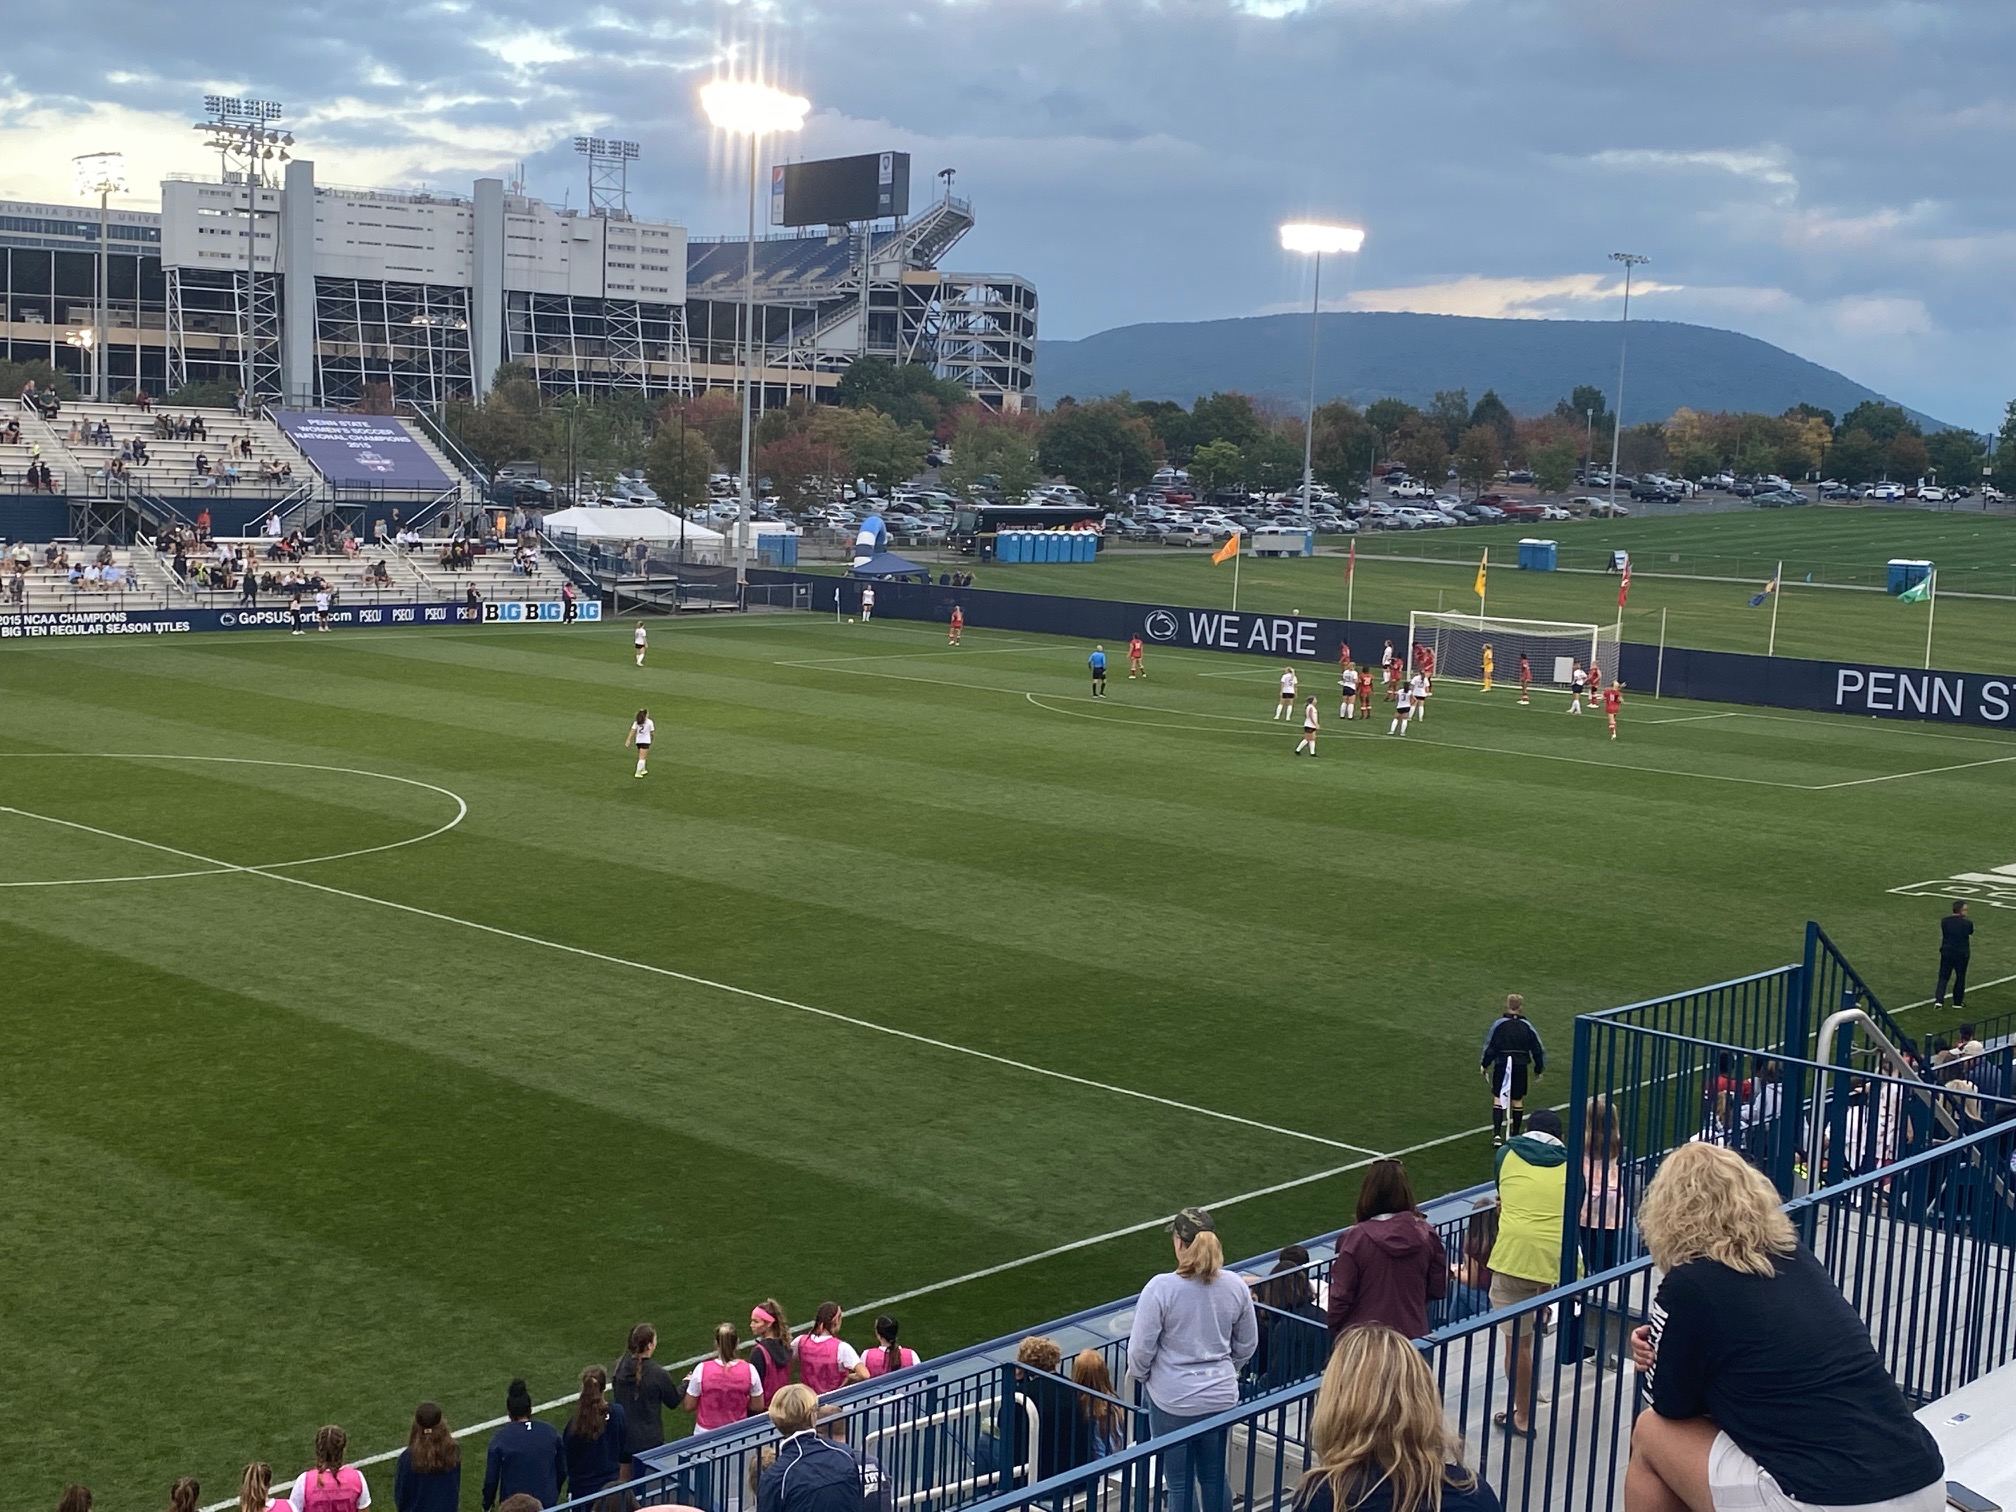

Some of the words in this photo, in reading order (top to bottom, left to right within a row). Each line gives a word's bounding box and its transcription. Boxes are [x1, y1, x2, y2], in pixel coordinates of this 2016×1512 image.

[298, 426, 350, 434] WOMEN'S
[338, 420, 371, 428] STATE
[294, 432, 348, 441] NATIONAL
[348, 434, 412, 443] CHAMPIONS
[346, 441, 372, 449] 2015
[0, 614, 21, 626] 2015
[23, 614, 57, 625] NCAA
[59, 612, 127, 624] CHAMPIONS
[239, 611, 352, 625] GoPSUSortscom
[359, 609, 383, 622] PSECU
[392, 608, 415, 621] PSECU
[424, 607, 447, 620] PSECU
[457, 607, 478, 620] PSEU
[1, 626, 22, 638] BIG
[24, 625, 47, 637] TEN
[49, 624, 104, 636] REGULAR
[106, 622, 152, 634] SEASON
[153, 621, 190, 633] TITLES
[1188, 612, 1240, 648] WE
[1247, 618, 1318, 655] ARE
[1835, 669, 1964, 716] PENN
[1979, 681, 2016, 721] S
[525, 1421, 532, 1431] 7
